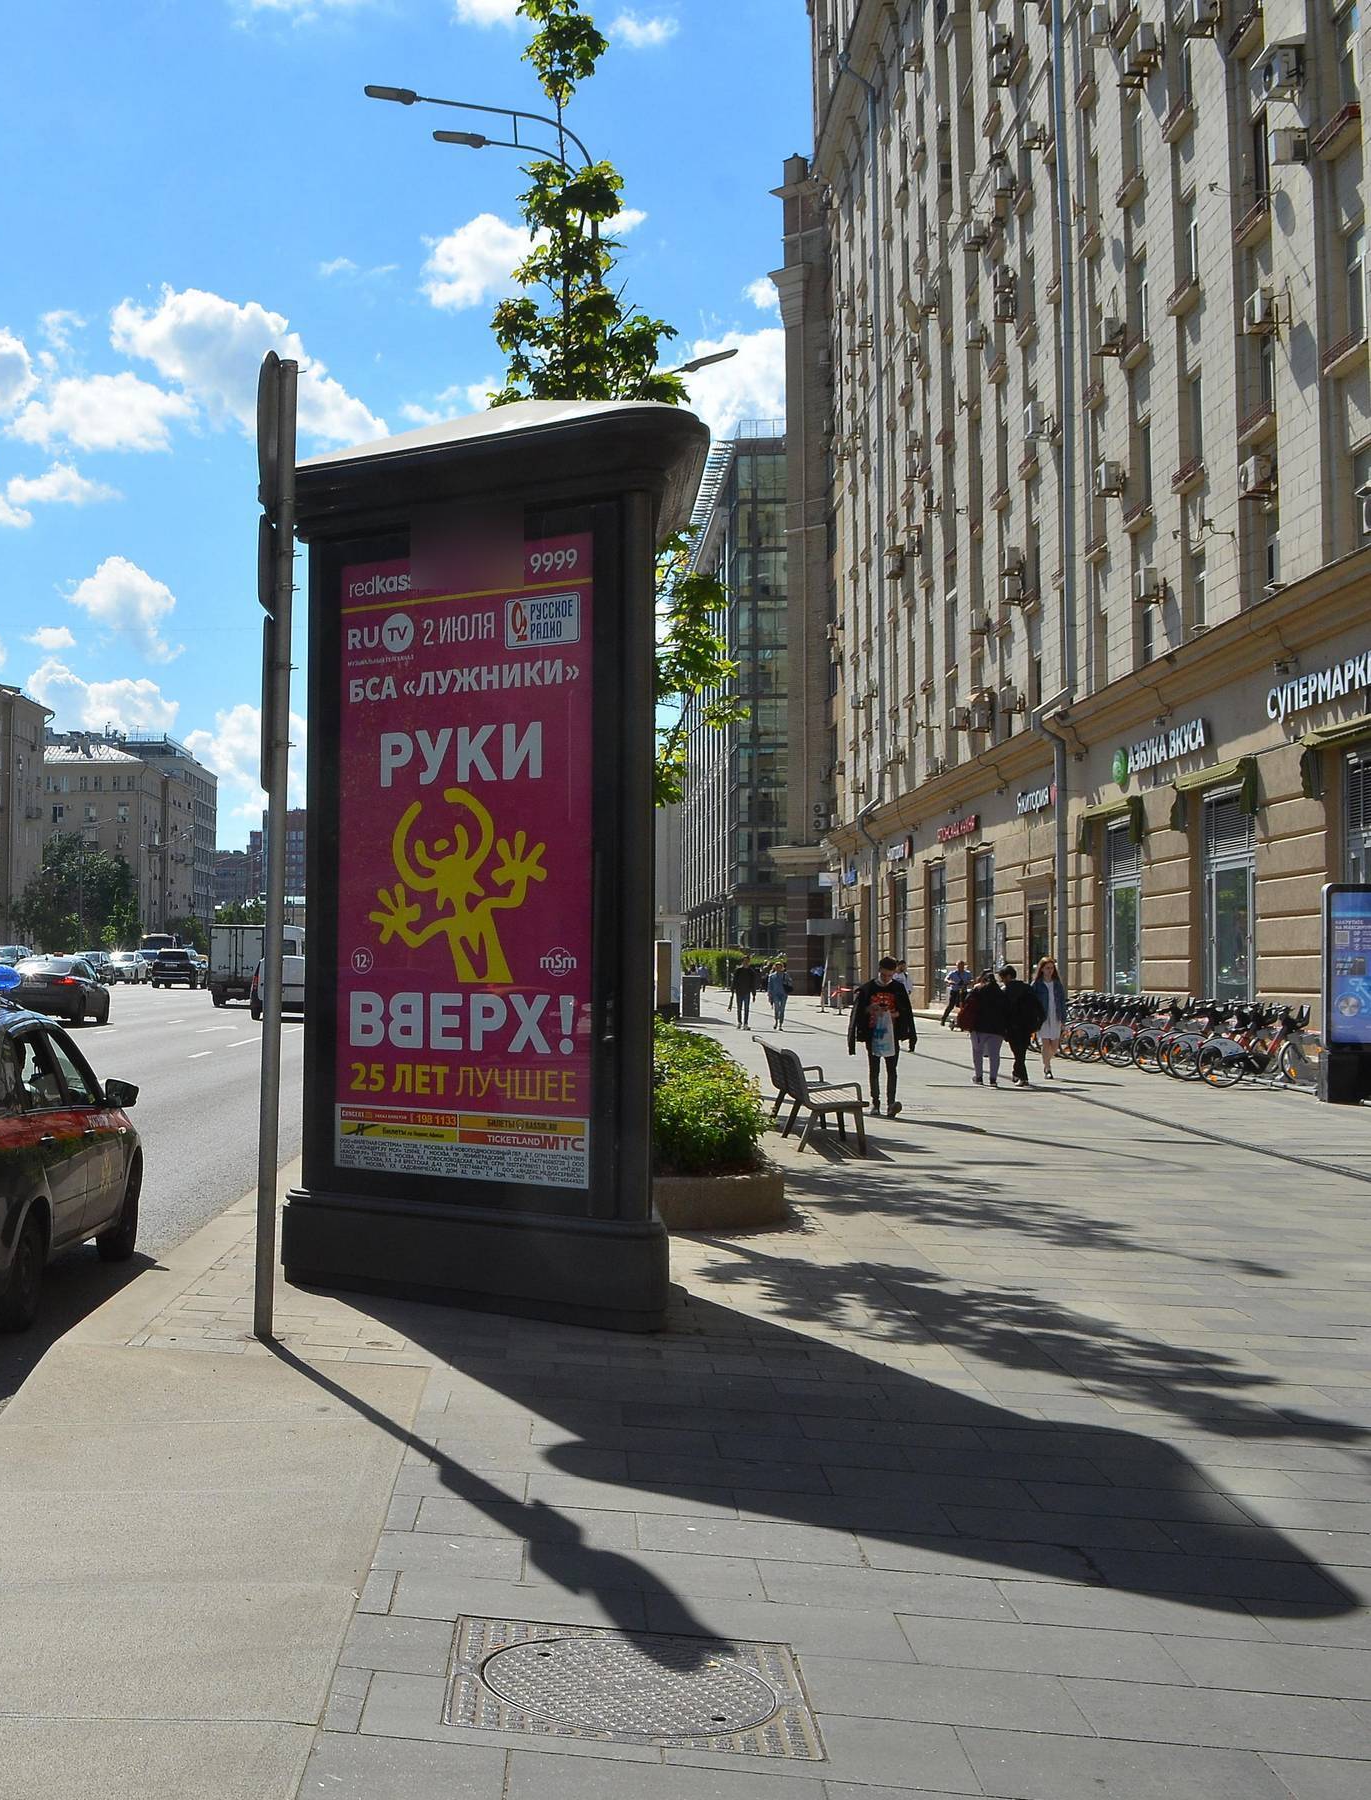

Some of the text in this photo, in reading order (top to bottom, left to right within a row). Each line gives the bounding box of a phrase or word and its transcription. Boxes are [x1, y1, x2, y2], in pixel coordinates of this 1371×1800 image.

[530, 548, 578, 573] 9999
[530, 599, 573, 621] РУССКОЕ
[347, 625, 408, 650] RU TV
[423, 612, 496, 646] 2 ИЮЛЯ
[530, 619, 563, 640] РАДИО
[349, 659, 580, 703] БСА «ЛУЖНИКИ»
[1266, 650, 1371, 724] СУПЕРМАРК
[380, 721, 543, 787] РУКИ
[1127, 718, 1205, 774] АЗБУКА ВКУСА
[354, 953, 371, 970] 12+
[349, 991, 575, 1054] ВВЕРХ!
[350, 1063, 576, 1102] 25 ЛЕТ ЛУЧШЕЕ
[487, 1134, 541, 1146] TICKETLAND
